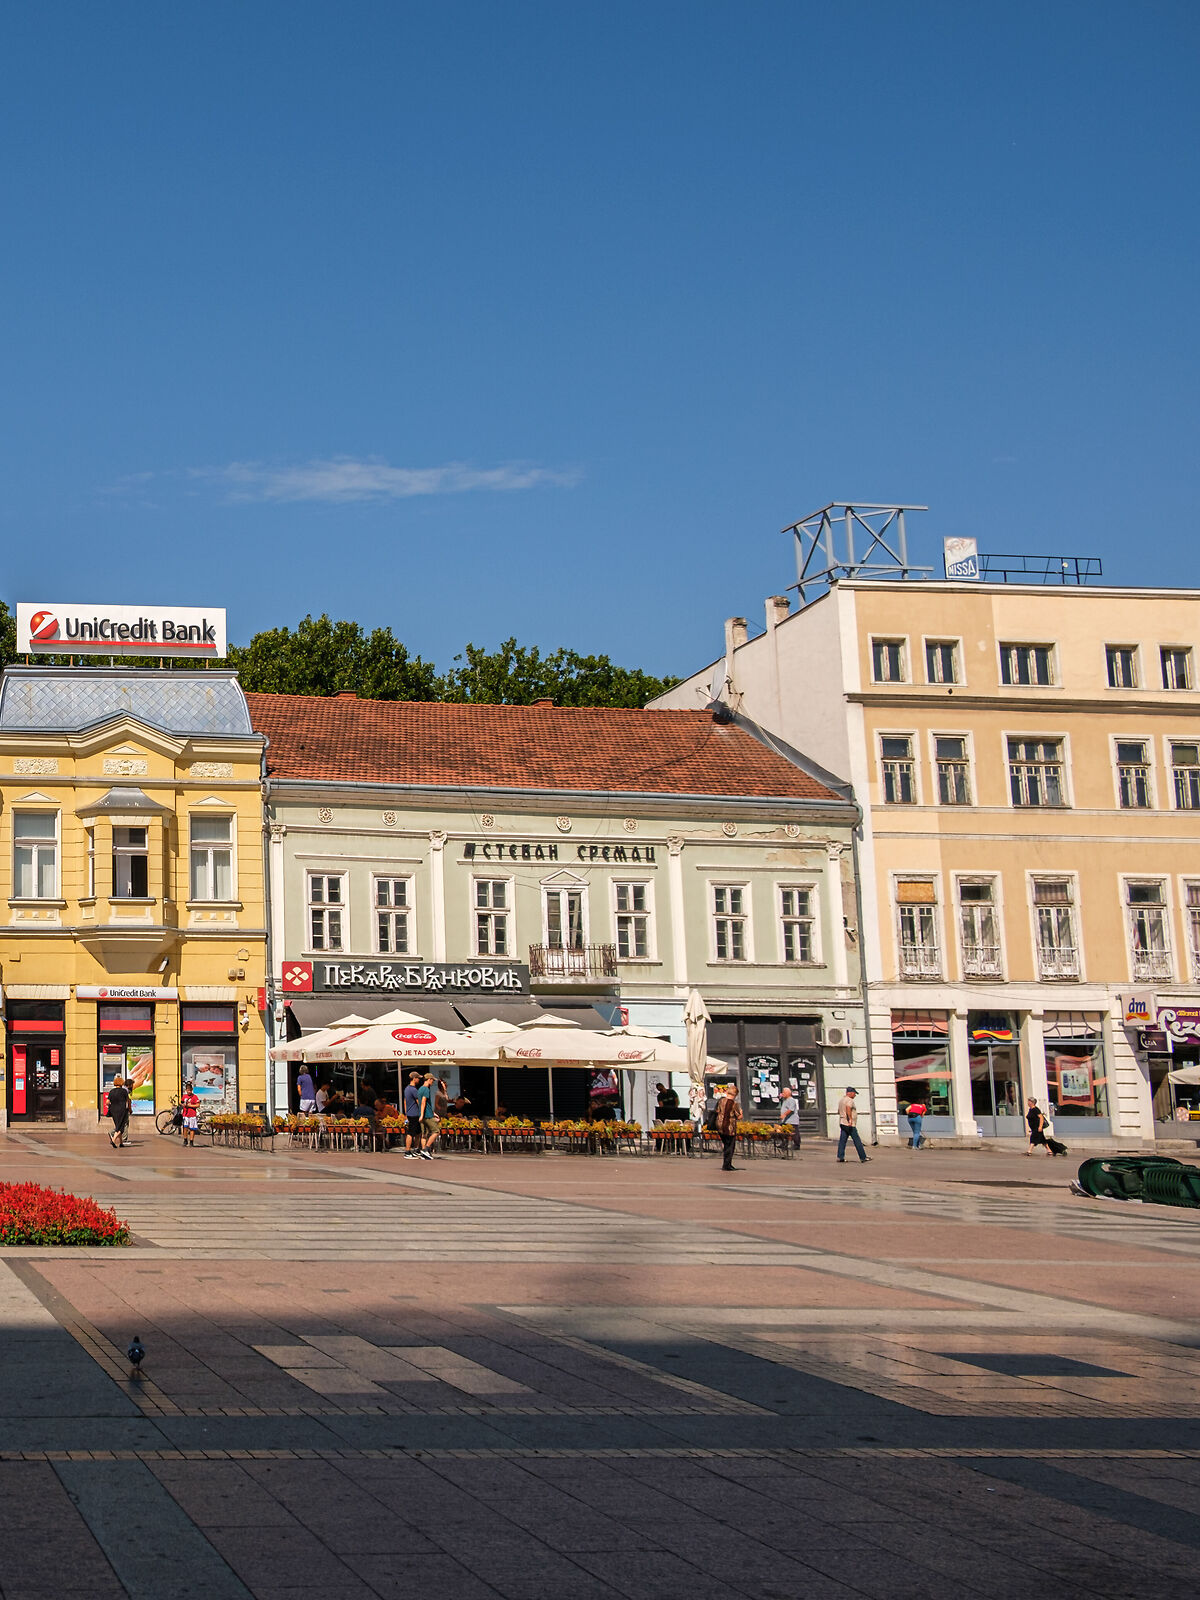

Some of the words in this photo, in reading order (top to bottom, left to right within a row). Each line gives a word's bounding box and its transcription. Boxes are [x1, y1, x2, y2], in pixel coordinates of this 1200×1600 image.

[948, 560, 975, 575] NISSA
[66, 617, 156, 639] UniCredit
[162, 618, 215, 641] Bank
[483, 843, 558, 861] СТЕВАН
[577, 845, 656, 863] СРЕМАЦ
[110, 989, 139, 997] UniCredit
[140, 990, 157, 998] Bank
[1129, 998, 1146, 1013] dm
[516, 1048, 542, 1057] Coca-Cola
